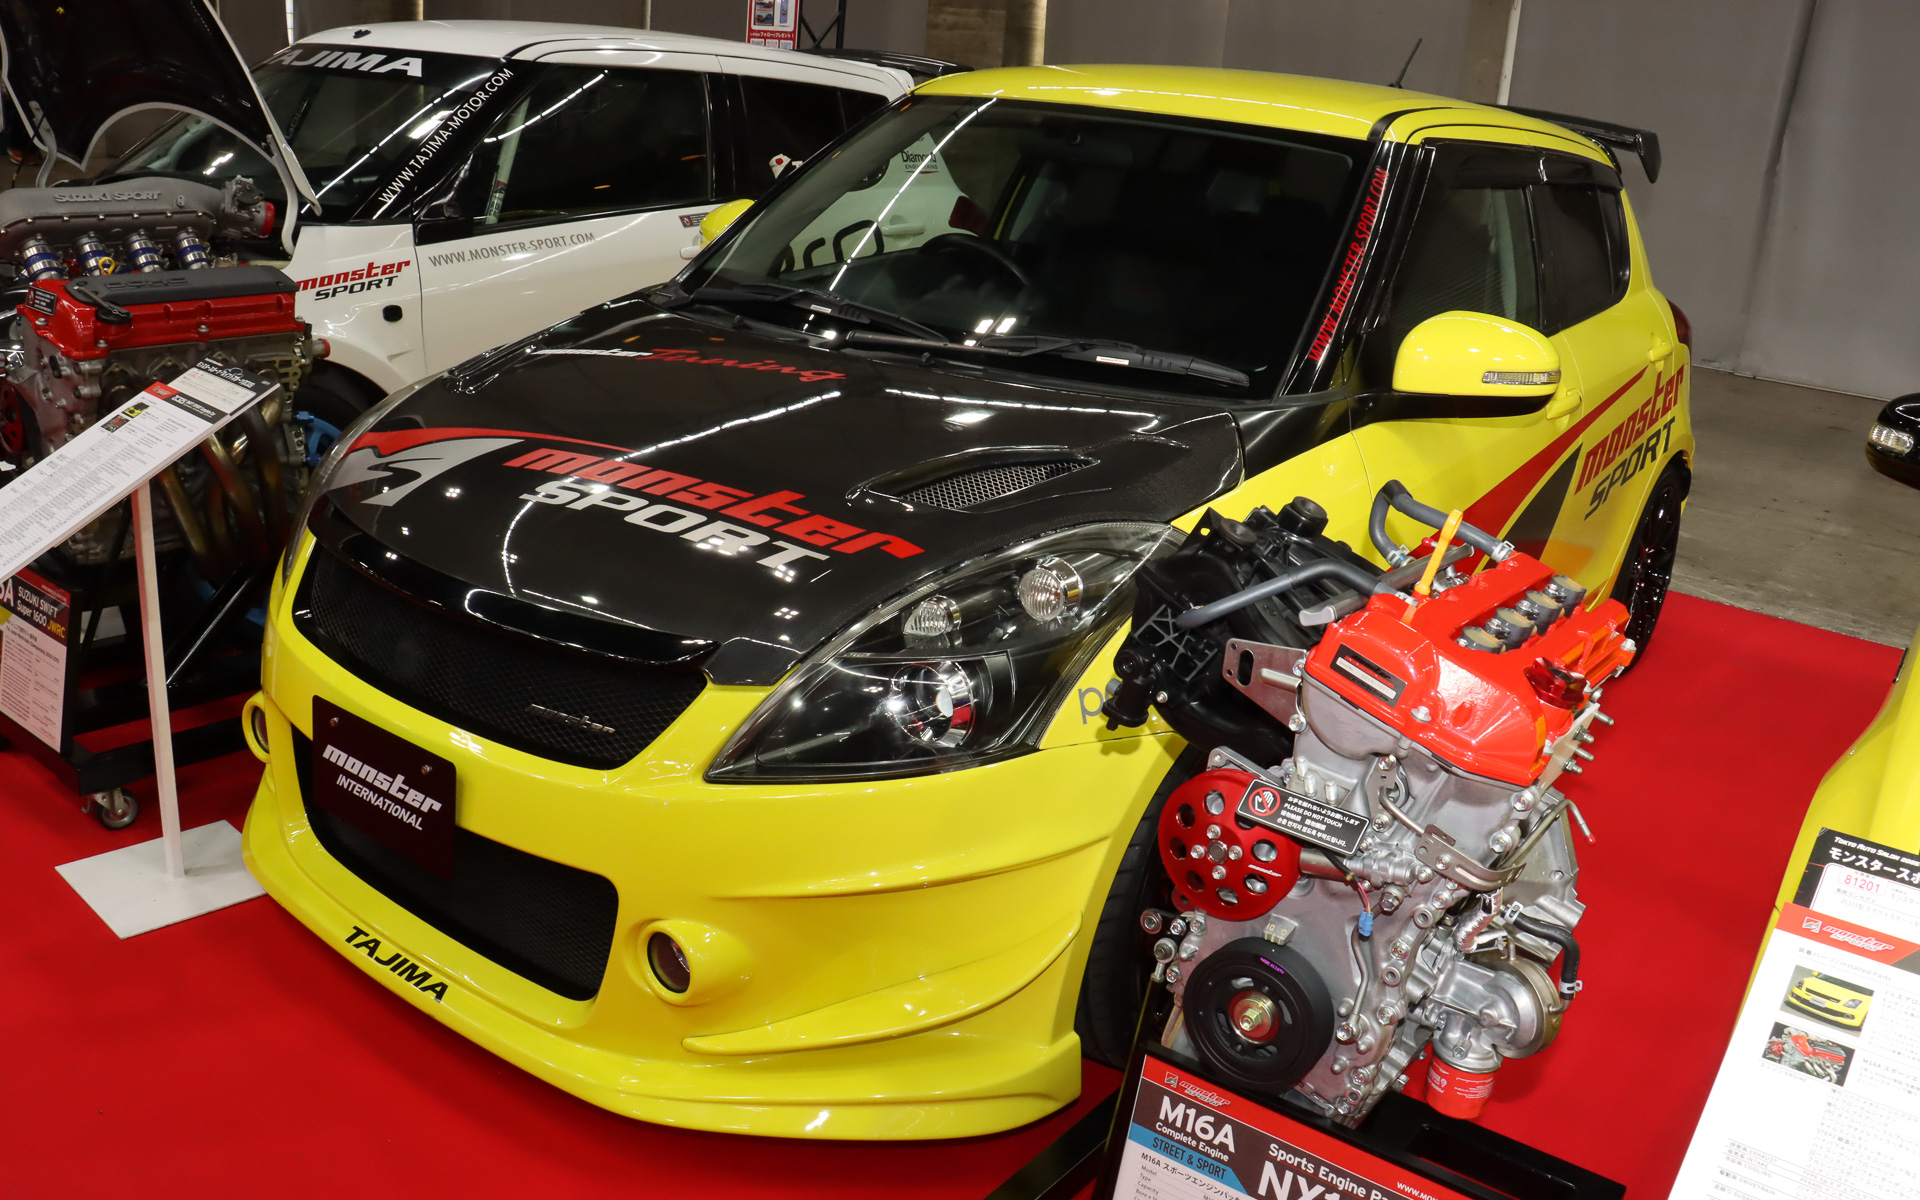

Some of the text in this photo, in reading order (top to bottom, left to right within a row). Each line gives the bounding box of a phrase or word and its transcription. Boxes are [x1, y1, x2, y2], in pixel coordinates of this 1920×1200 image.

[379, 68, 514, 203] WWW.TAJIMA-MOTOR.COM
[54, 191, 161, 203] SUZUKI SPORT
[429, 232, 596, 268] WWW.MONSTER-SPORT.COM
[1308, 167, 1390, 364] WWW.MONSTER-SPORT.COM
[296, 261, 411, 292] monster
[315, 275, 398, 301] SPORT
[636, 348, 846, 382] Tuning
[1574, 364, 1685, 495] monster
[1584, 416, 1675, 522] SPORT
[502, 447, 925, 559] monster
[519, 480, 830, 570] SPORT
[16, 600, 32, 618] Super
[32, 610, 48, 627] 1600
[47, 620, 66, 639] JWRC
[18, 586, 40, 607] SUZUKI
[40, 599, 58, 618] SWIFT
[322, 744, 442, 813] monster
[336, 774, 424, 831] INTERNATIONAL
[1284, 803, 1304, 814] PLEASE
[1312, 812, 1323, 821] NOT
[1323, 817, 1343, 829] TOUCH
[1844, 874, 1880, 893] 81201
[1822, 925, 1895, 950] monster
[345, 926, 449, 1004] TAJIMA
[1179, 1080, 1231, 1106] monster
[1156, 1122, 1229, 1162] Complete Engine
[1159, 1095, 1235, 1153] M16A
[1139, 1173, 1152, 1183] Type
[1141, 1152, 1161, 1167] M16A
[1141, 1165, 1158, 1176] Model
[1152, 1137, 1227, 1180] STREET & SPORT
[1268, 1143, 1315, 1174] Sports
[1318, 1165, 1366, 1199] Engine
[1137, 1181, 1159, 1195] Capacity
[1257, 1160, 1342, 1200] NX
